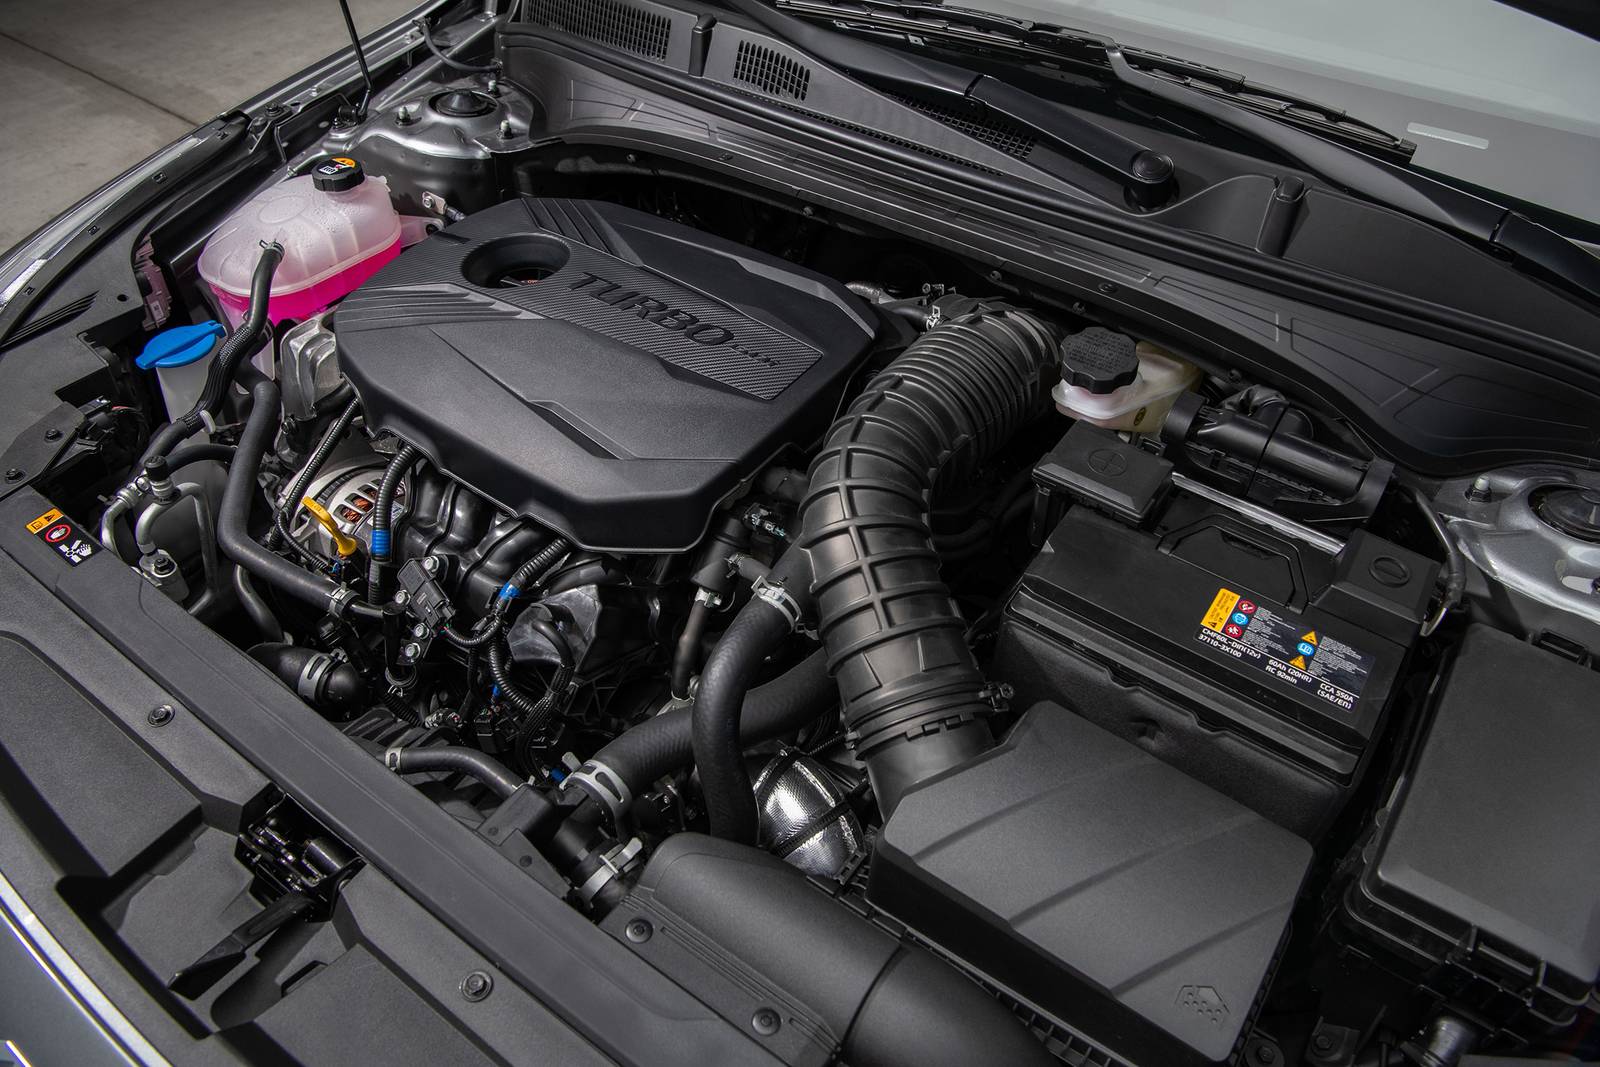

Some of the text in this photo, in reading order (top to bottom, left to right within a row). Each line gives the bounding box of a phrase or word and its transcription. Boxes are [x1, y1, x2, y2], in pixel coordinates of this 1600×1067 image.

[568, 271, 735, 346] TURBO
[1265, 665, 1298, 684] RC 92min
[1268, 659, 1312, 683] 60Ah (20HR)
[1319, 682, 1355, 703] CCA 550A
